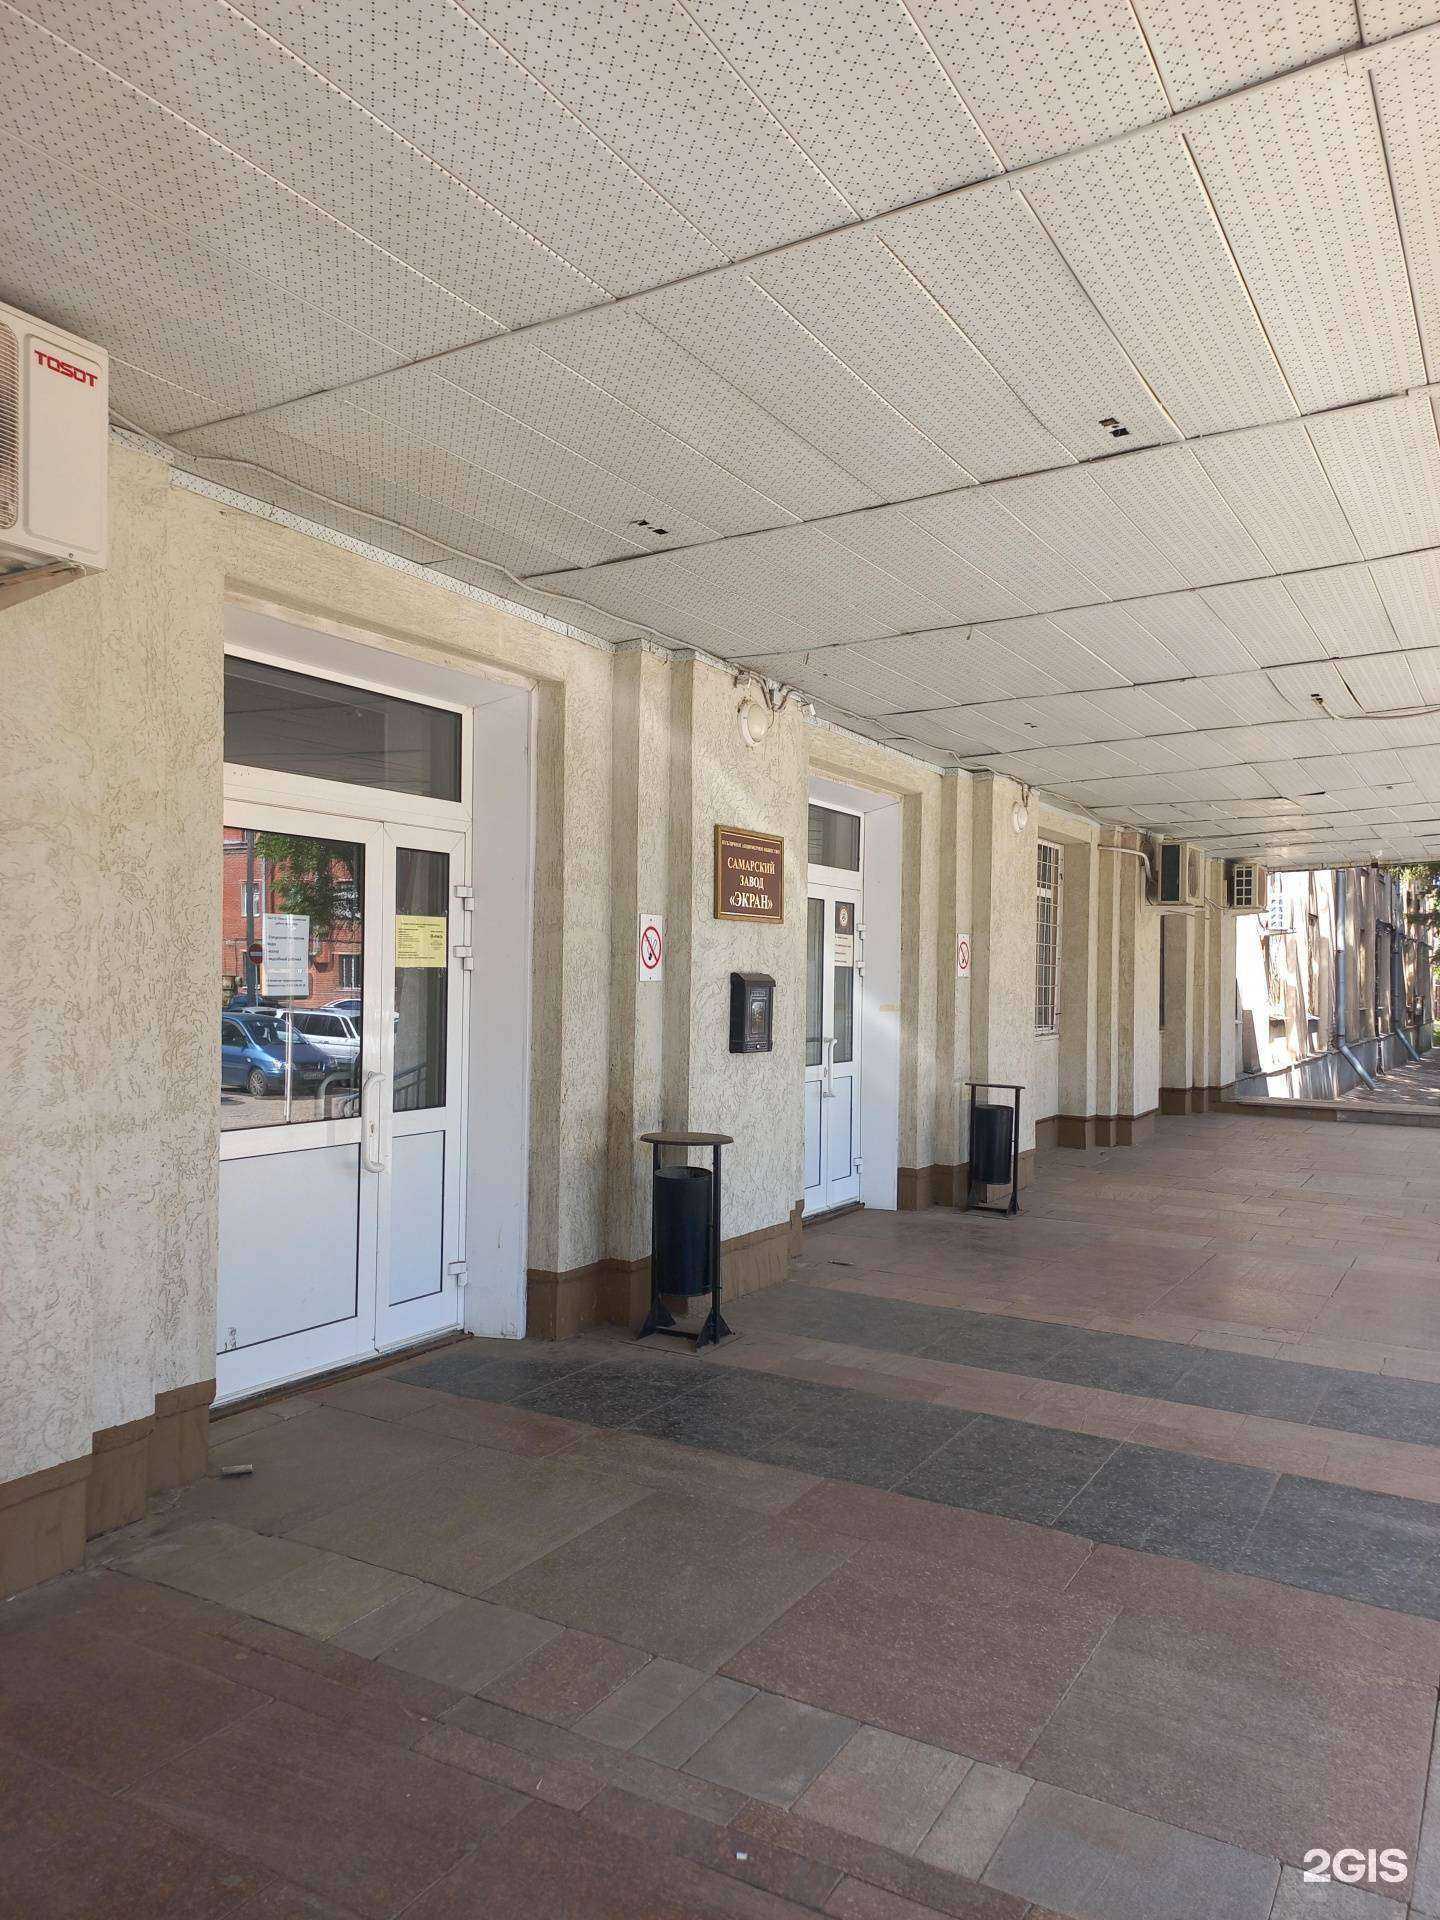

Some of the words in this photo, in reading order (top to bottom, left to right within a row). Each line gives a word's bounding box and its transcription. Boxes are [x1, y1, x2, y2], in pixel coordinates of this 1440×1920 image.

[34, 349, 98, 387] TOSOT
[727, 856, 776, 875] САМАРСКИЙ
[739, 874, 765, 890] ЗАВОД
[729, 891, 774, 910] «ЭКРАН»
